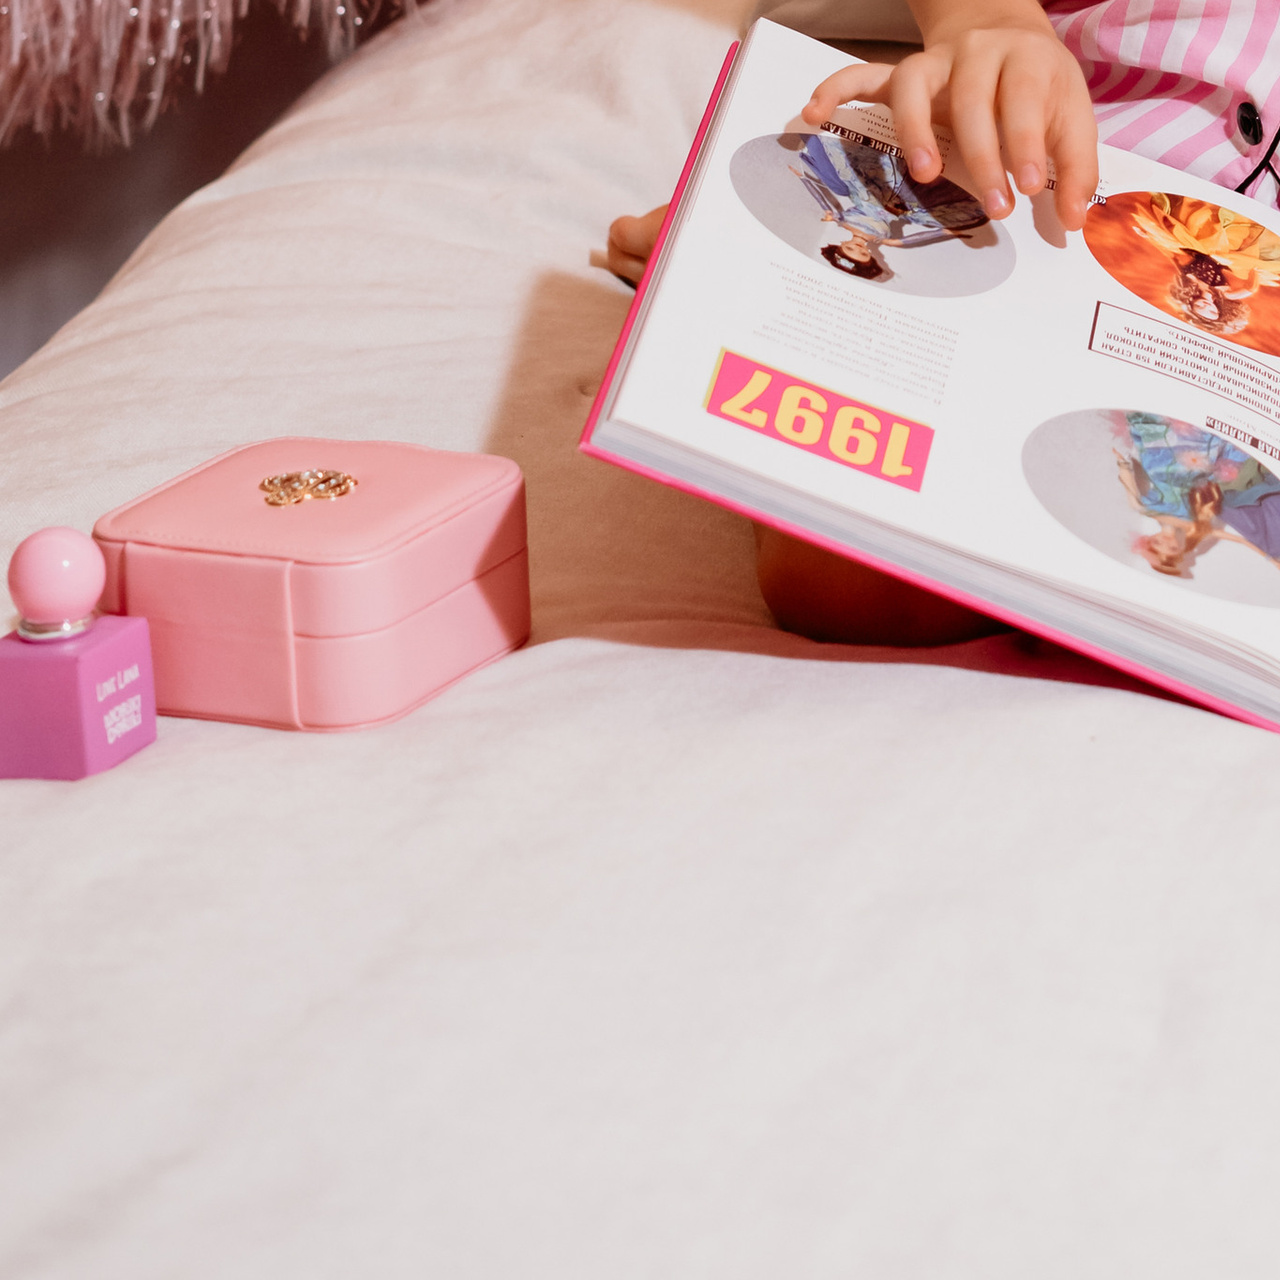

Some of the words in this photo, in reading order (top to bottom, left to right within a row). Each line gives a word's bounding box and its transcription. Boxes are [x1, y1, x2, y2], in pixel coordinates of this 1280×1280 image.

[820, 122, 864, 146] СВЕТА»
[1101, 342, 1132, 358] СТРАН
[1123, 326, 1178, 351] СОКРАТИТЬ
[1135, 353, 1150, 364] 159
[1160, 350, 1208, 374] КИОТСКИЙ
[1181, 345, 1219, 369] ПОМОЧЬ
[1154, 359, 1233, 396] ПРЕДСТАВИТЕЛИ
[1236, 392, 1271, 414] ЯПОНИИ
[720, 370, 913, 477] 1997
